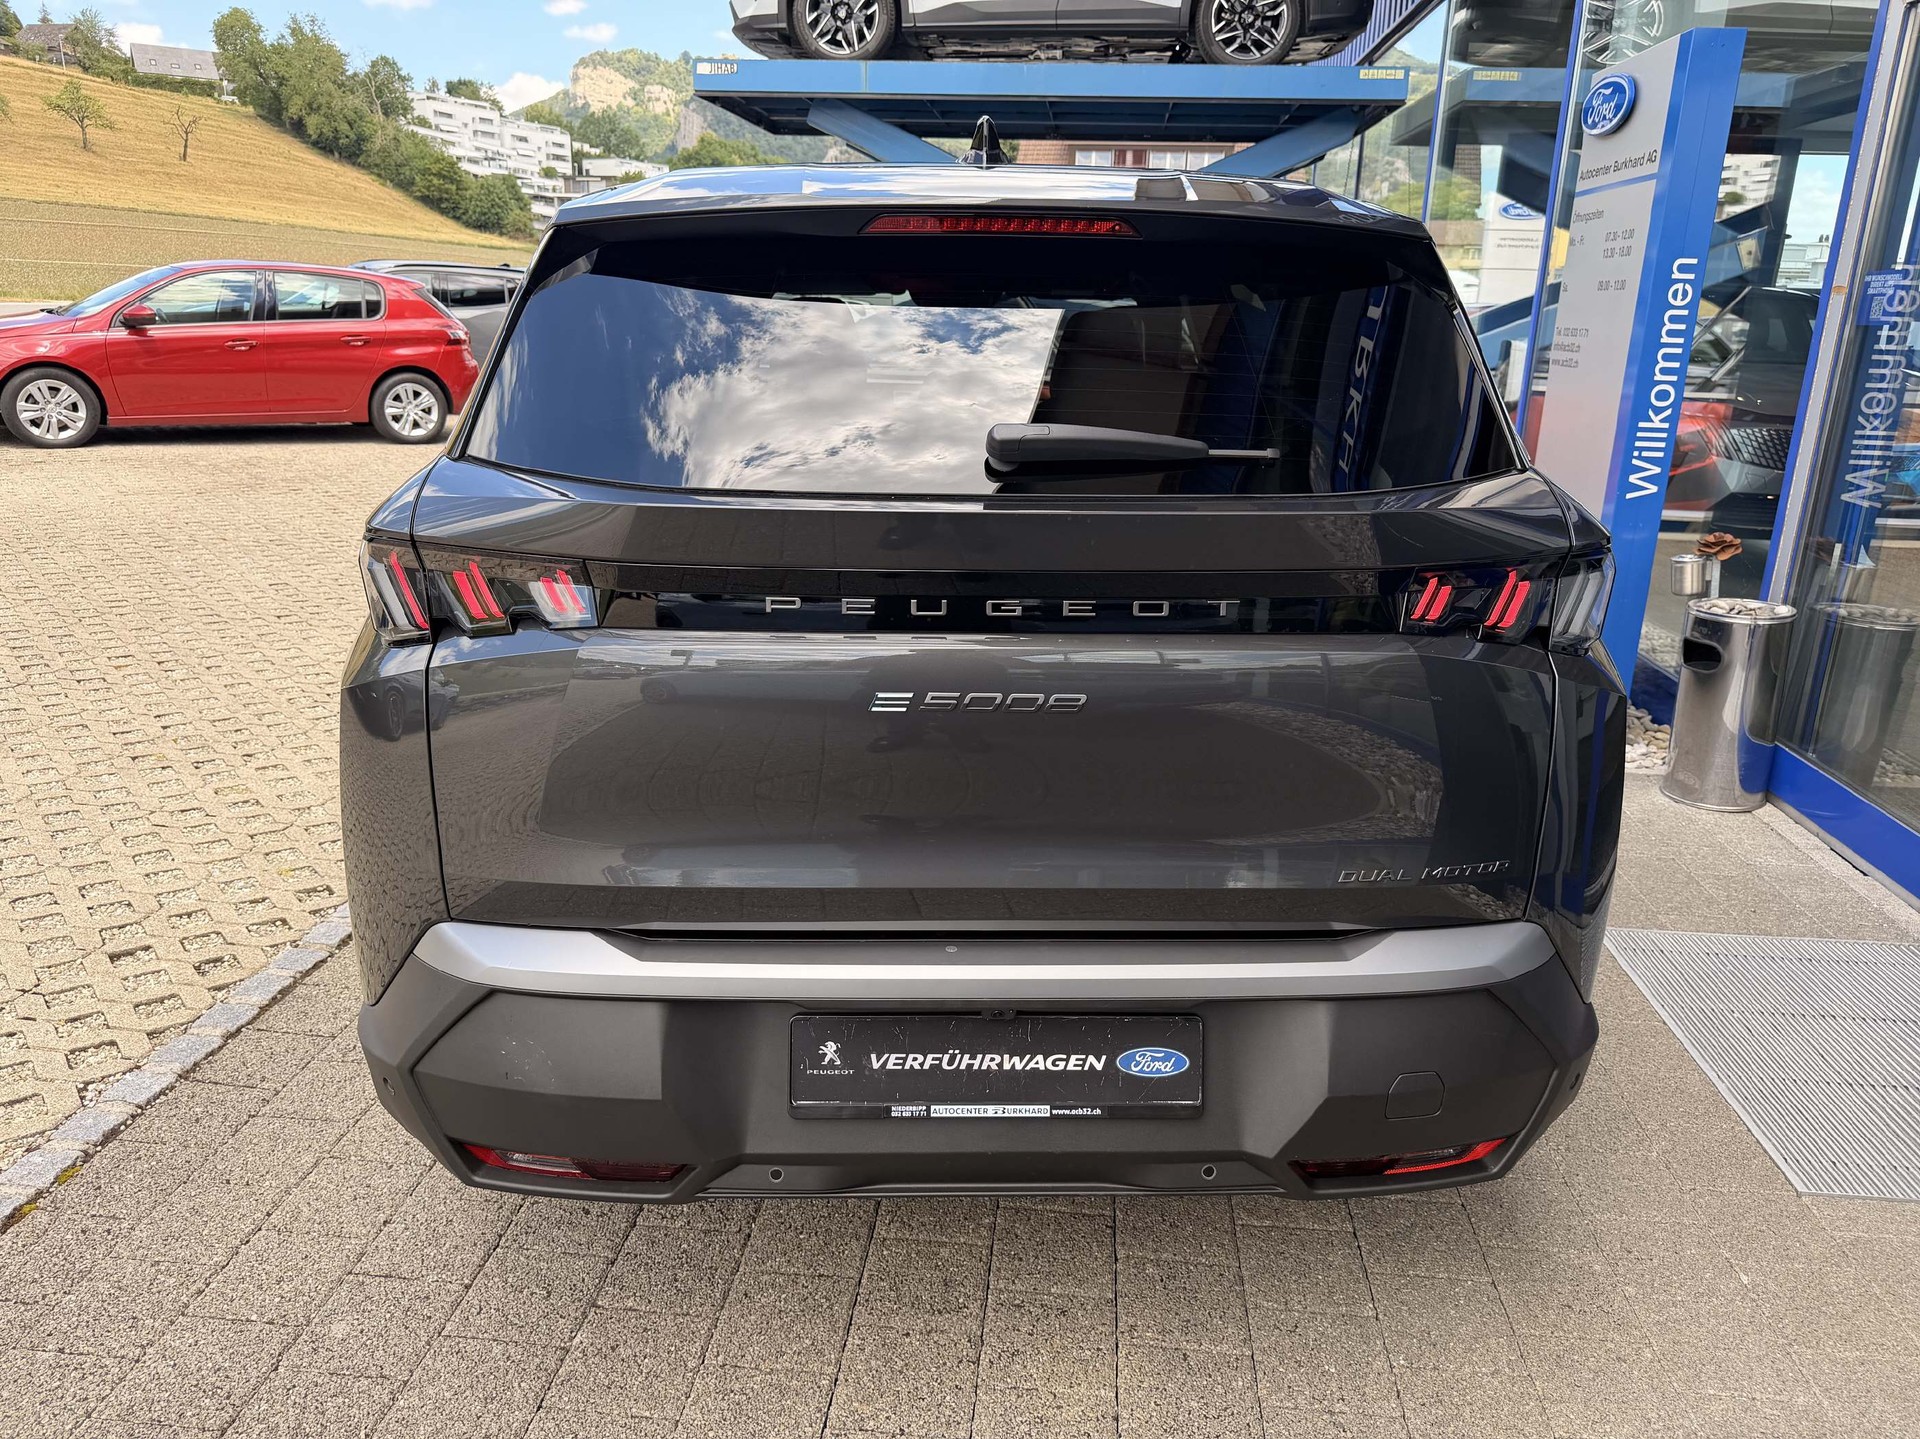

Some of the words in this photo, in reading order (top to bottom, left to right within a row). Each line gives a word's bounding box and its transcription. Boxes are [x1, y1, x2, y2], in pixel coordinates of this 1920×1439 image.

[1579, 164, 1612, 182] Autocenter
[1613, 153, 1646, 173] Burkhard
[1646, 149, 1658, 165] AG
[1625, 256, 1699, 500] Willkommen
[765, 596, 1241, 617] PEUGEOT
[919, 692, 1088, 713] 5008
[1338, 869, 1412, 883] DUAL
[1421, 860, 1510, 880] MOTOR
[870, 1050, 1107, 1071] VERFÜHRWAGEN
[932, 1106, 989, 1116] AUTOCENTER
